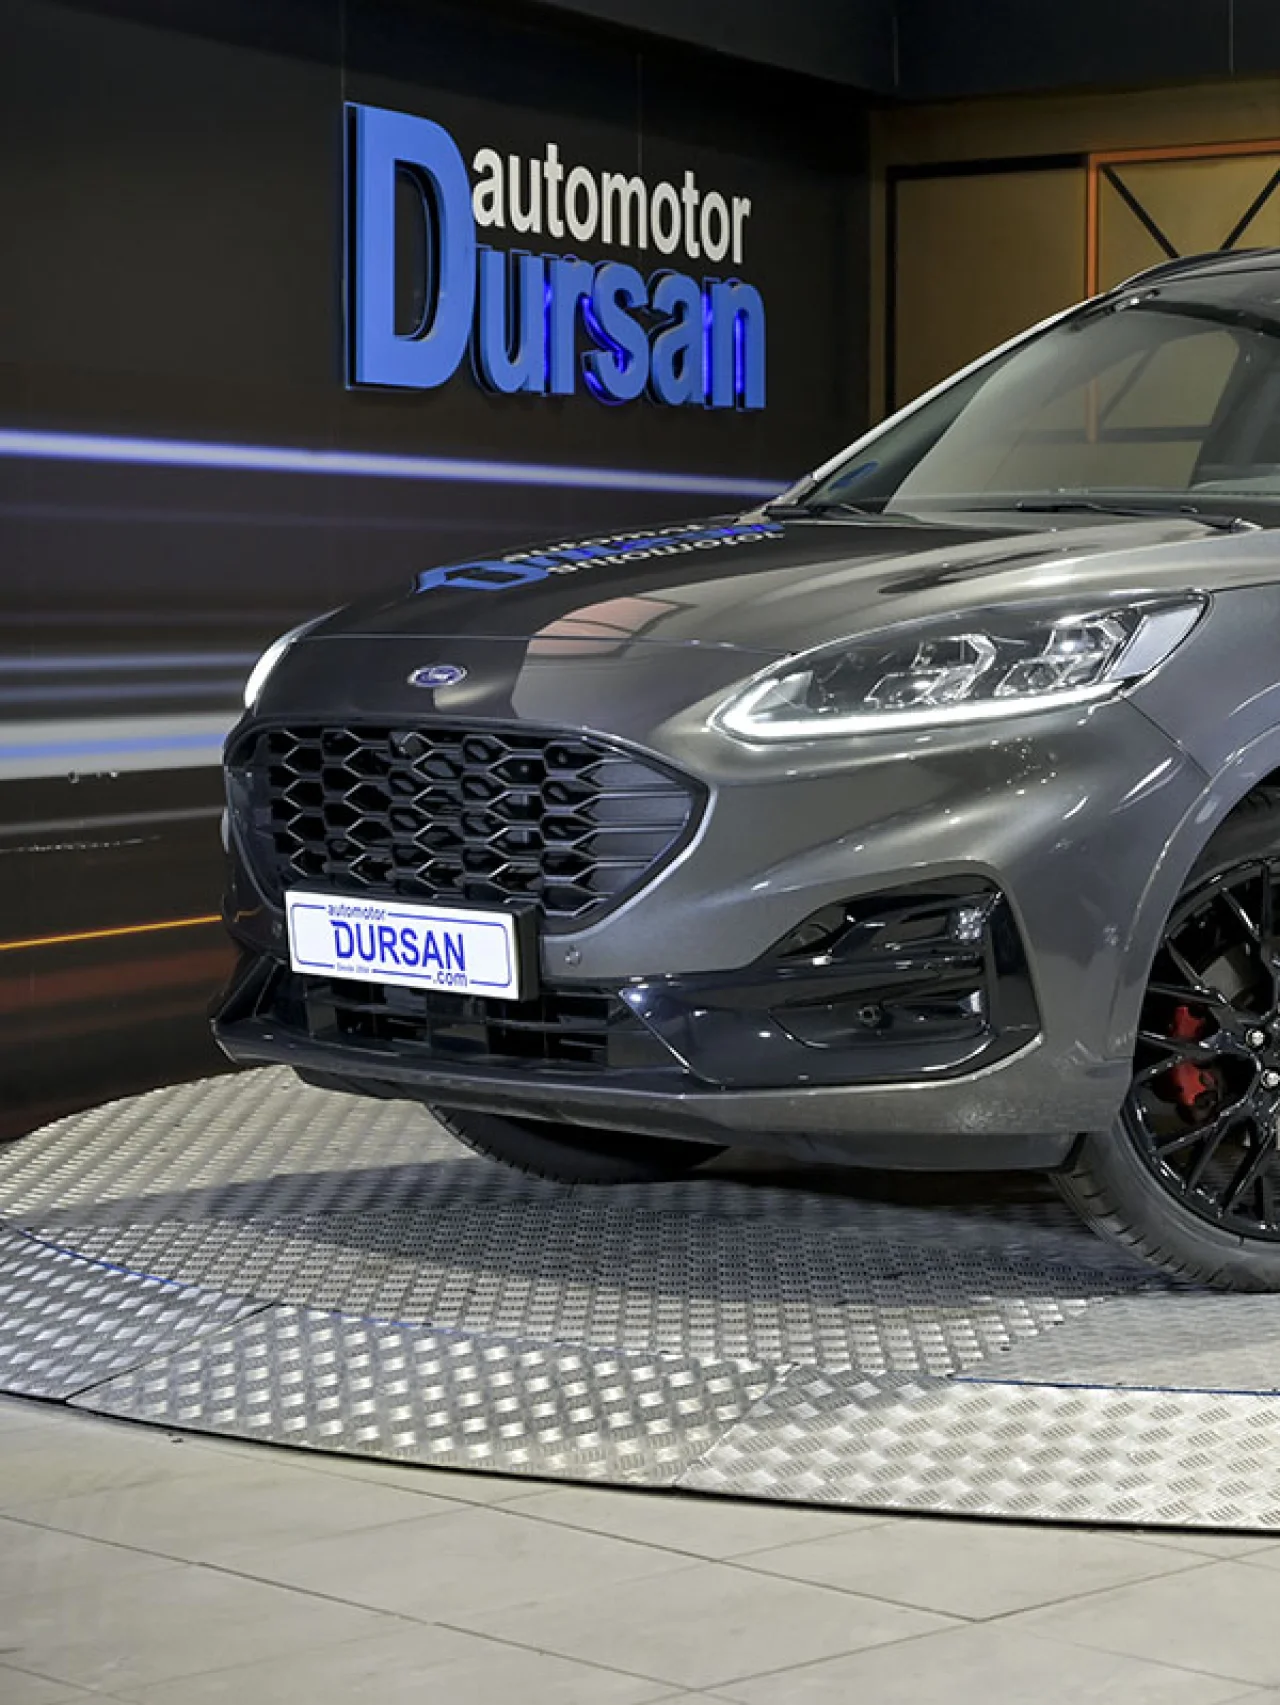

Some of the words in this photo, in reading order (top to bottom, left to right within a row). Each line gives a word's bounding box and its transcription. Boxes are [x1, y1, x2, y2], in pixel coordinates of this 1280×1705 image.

[471, 143, 751, 264] automotor
[343, 100, 767, 411] Dursan
[327, 904, 386, 922] automotor
[330, 919, 466, 972] DURSAN
[433, 970, 468, 988] .com
